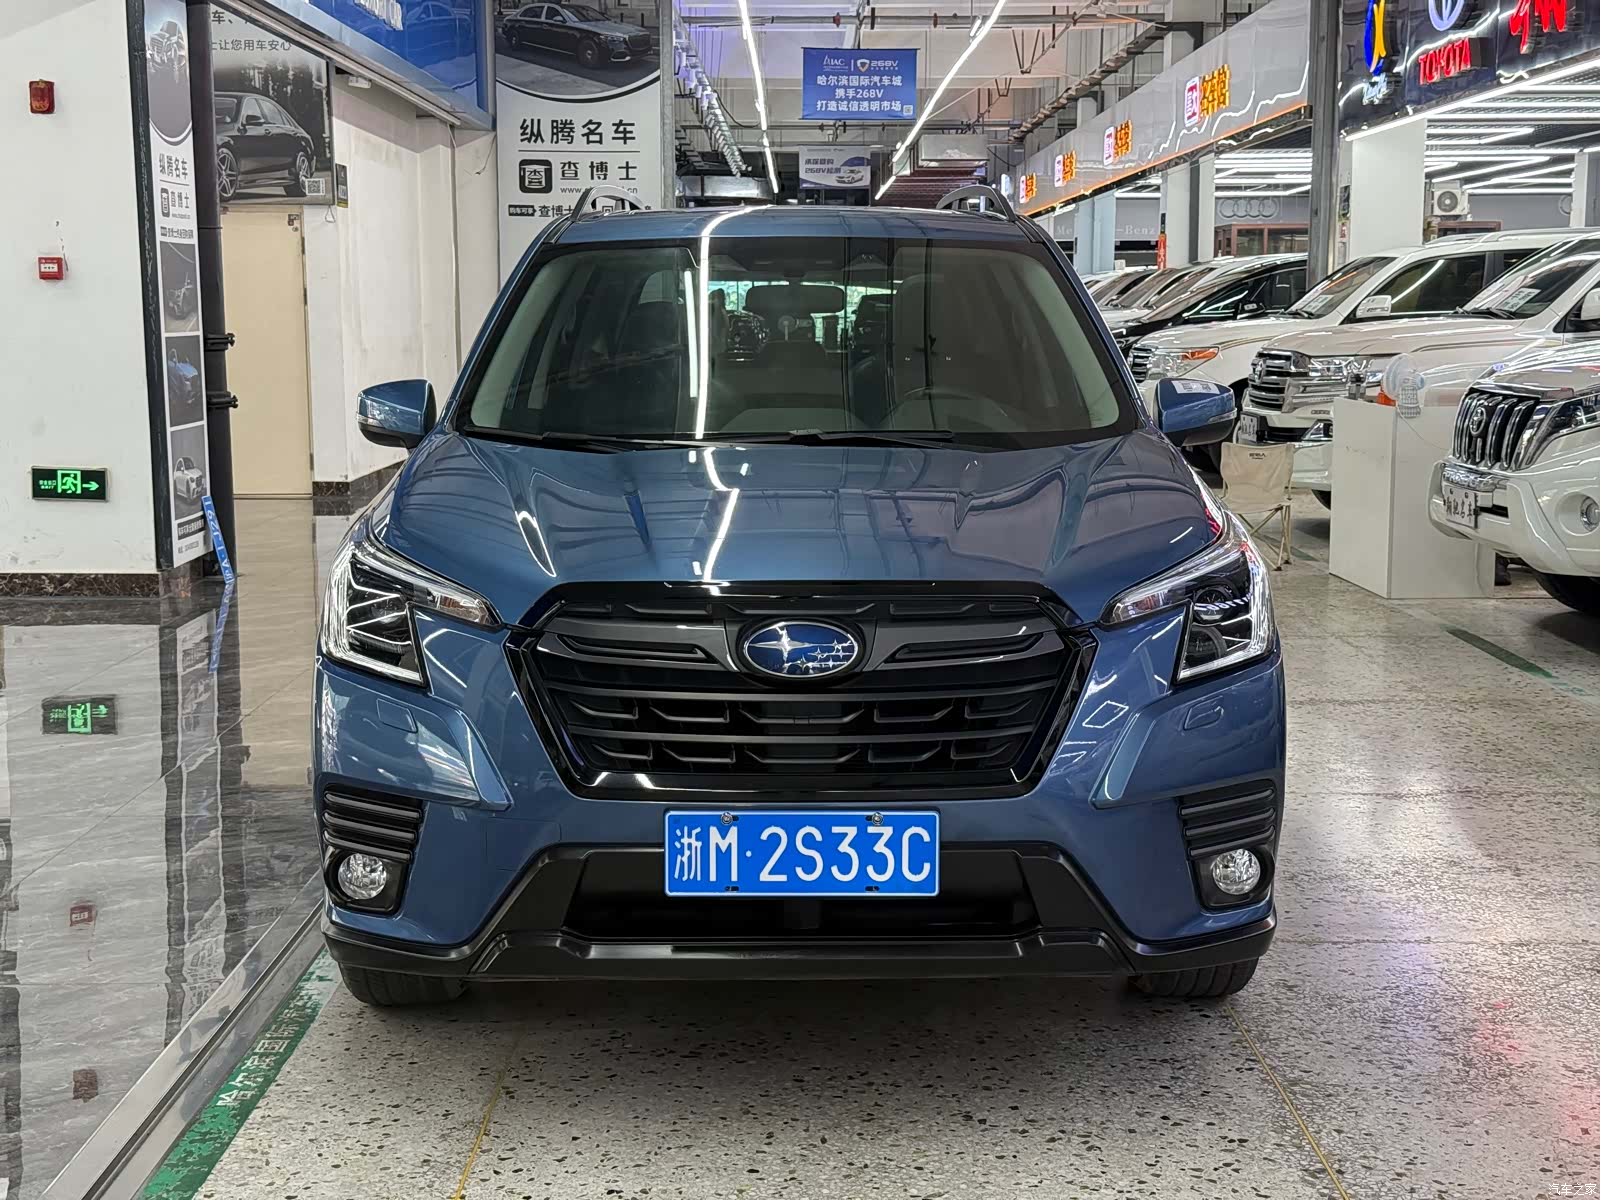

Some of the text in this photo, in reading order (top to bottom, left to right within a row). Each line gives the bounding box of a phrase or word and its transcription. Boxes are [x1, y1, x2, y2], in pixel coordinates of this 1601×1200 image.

[1418, 37, 1472, 85] TOYOTA
[816, 75, 903, 86] 哈尔滨国际汽车城
[834, 88, 884, 99] 携手268V
[816, 100, 902, 111] 打造诚信透明市场
[520, 118, 636, 145] 纵腾名车
[560, 161, 637, 181] 查博士
[673, 825, 932, 882] 浙M·2S33C
[215, 990, 318, 1107] 哈尔滨国际汽
